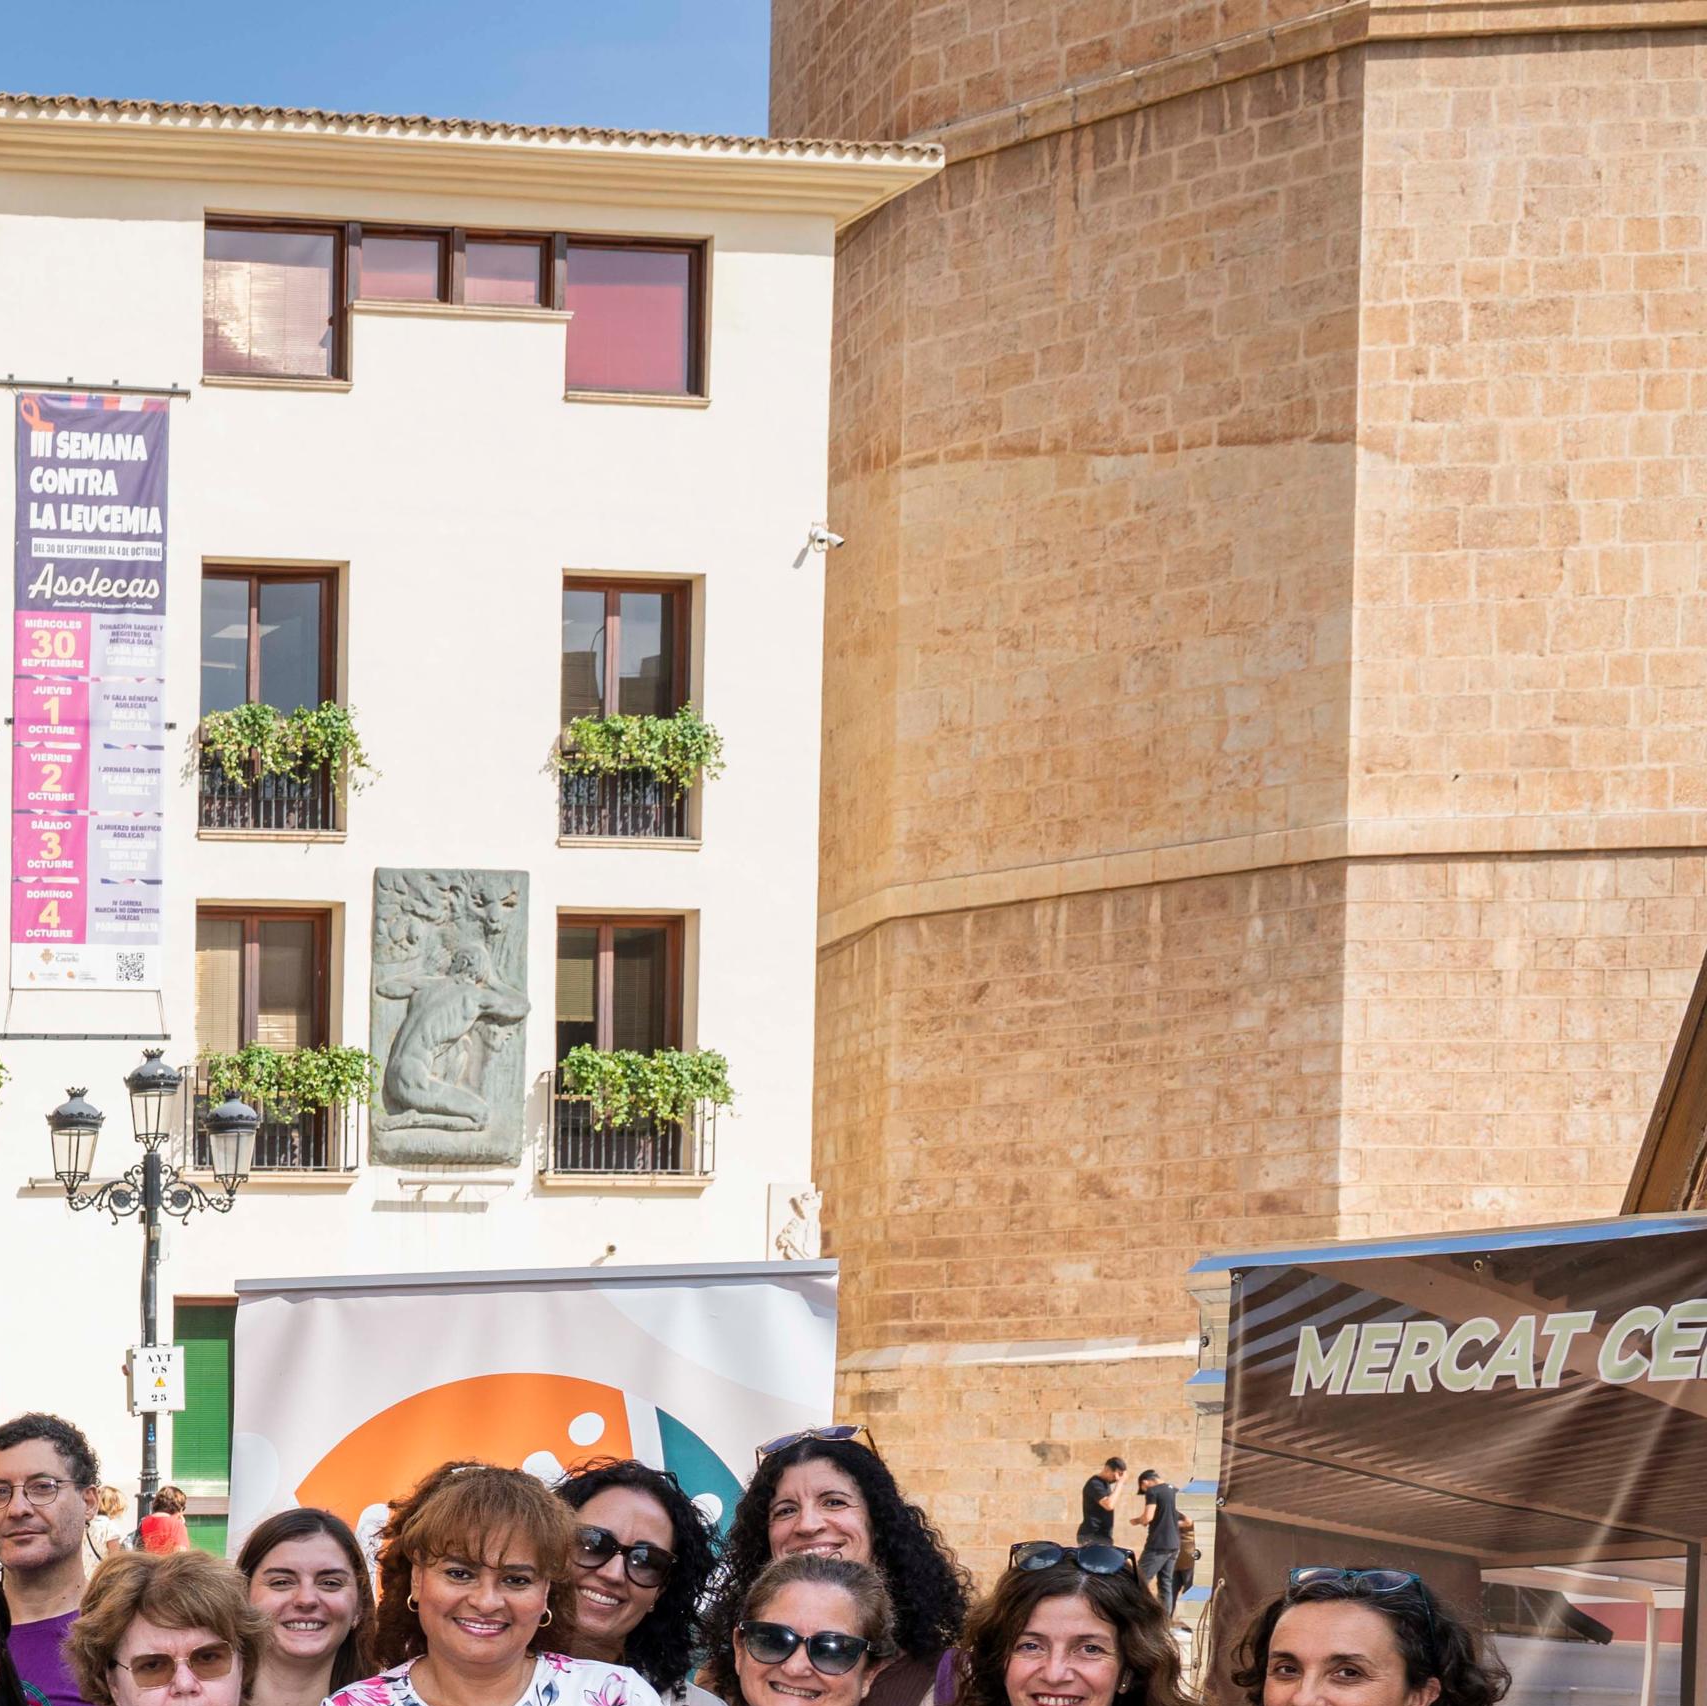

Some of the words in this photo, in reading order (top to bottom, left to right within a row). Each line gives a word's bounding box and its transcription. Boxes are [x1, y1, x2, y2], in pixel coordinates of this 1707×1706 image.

[30, 431, 52, 457] III
[57, 431, 147, 461] SEMANA
[30, 466, 118, 496] CONTRA
[29, 502, 57, 531] LA
[60, 504, 162, 535] LEUCEMIA
[34, 543, 44, 552] DEL
[46, 544, 55, 553] 30
[57, 545, 64, 554] DE
[67, 545, 106, 554] SEPTIEMBRE
[108, 546, 115, 555] AL
[117, 547, 121, 555] 4
[122, 547, 128, 556] DE
[131, 546, 160, 556] OCTUBRE
[28, 563, 160, 599] Asolecas
[25, 618, 82, 630] MIÉRCOLES
[31, 631, 75, 658] 30
[21, 658, 84, 668] SEPTIEMBRE
[33, 686, 72, 696] JUEVES
[43, 696, 60, 725] 1
[28, 726, 75, 735] OCTUBRE
[30, 753, 72, 763] VIERNES
[40, 765, 62, 792] 2
[28, 792, 75, 801] OCTUBRE
[31, 819, 71, 830] SÁBADO
[40, 832, 61, 860] 3
[27, 860, 74, 869] OCTUBRE
[26, 889, 73, 899] DOMINGO
[39, 901, 61, 928] 4
[26, 928, 73, 938] OCTUBRE
[1289, 1310, 1597, 1397] MERCAT
[1597, 1297, 1707, 1385] CE
